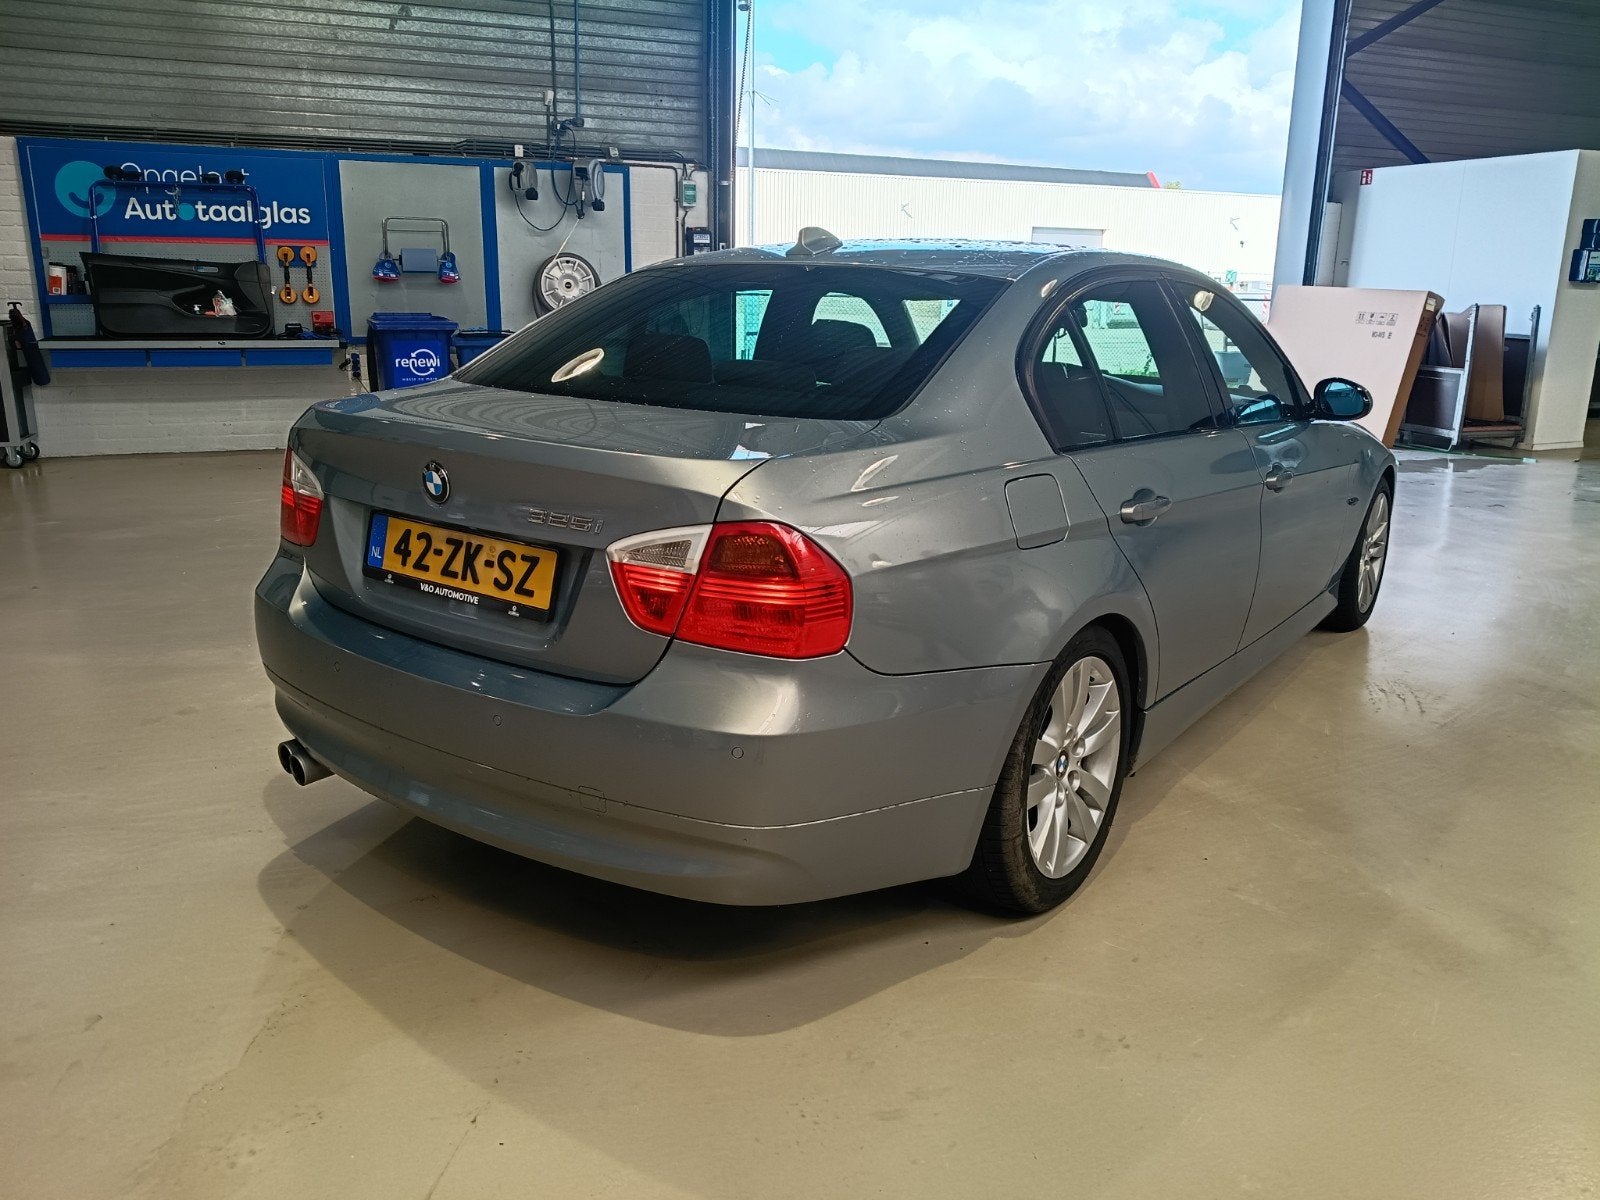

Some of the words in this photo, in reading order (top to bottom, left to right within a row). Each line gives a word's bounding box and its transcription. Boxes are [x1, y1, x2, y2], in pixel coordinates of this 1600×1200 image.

[395, 356, 440, 367] renewi
[371, 545, 382, 559] NL
[393, 528, 540, 598] 42-ZK-SZ
[420, 583, 434, 593] V&O
[434, 588, 479, 605] AUTOMOTIVE
